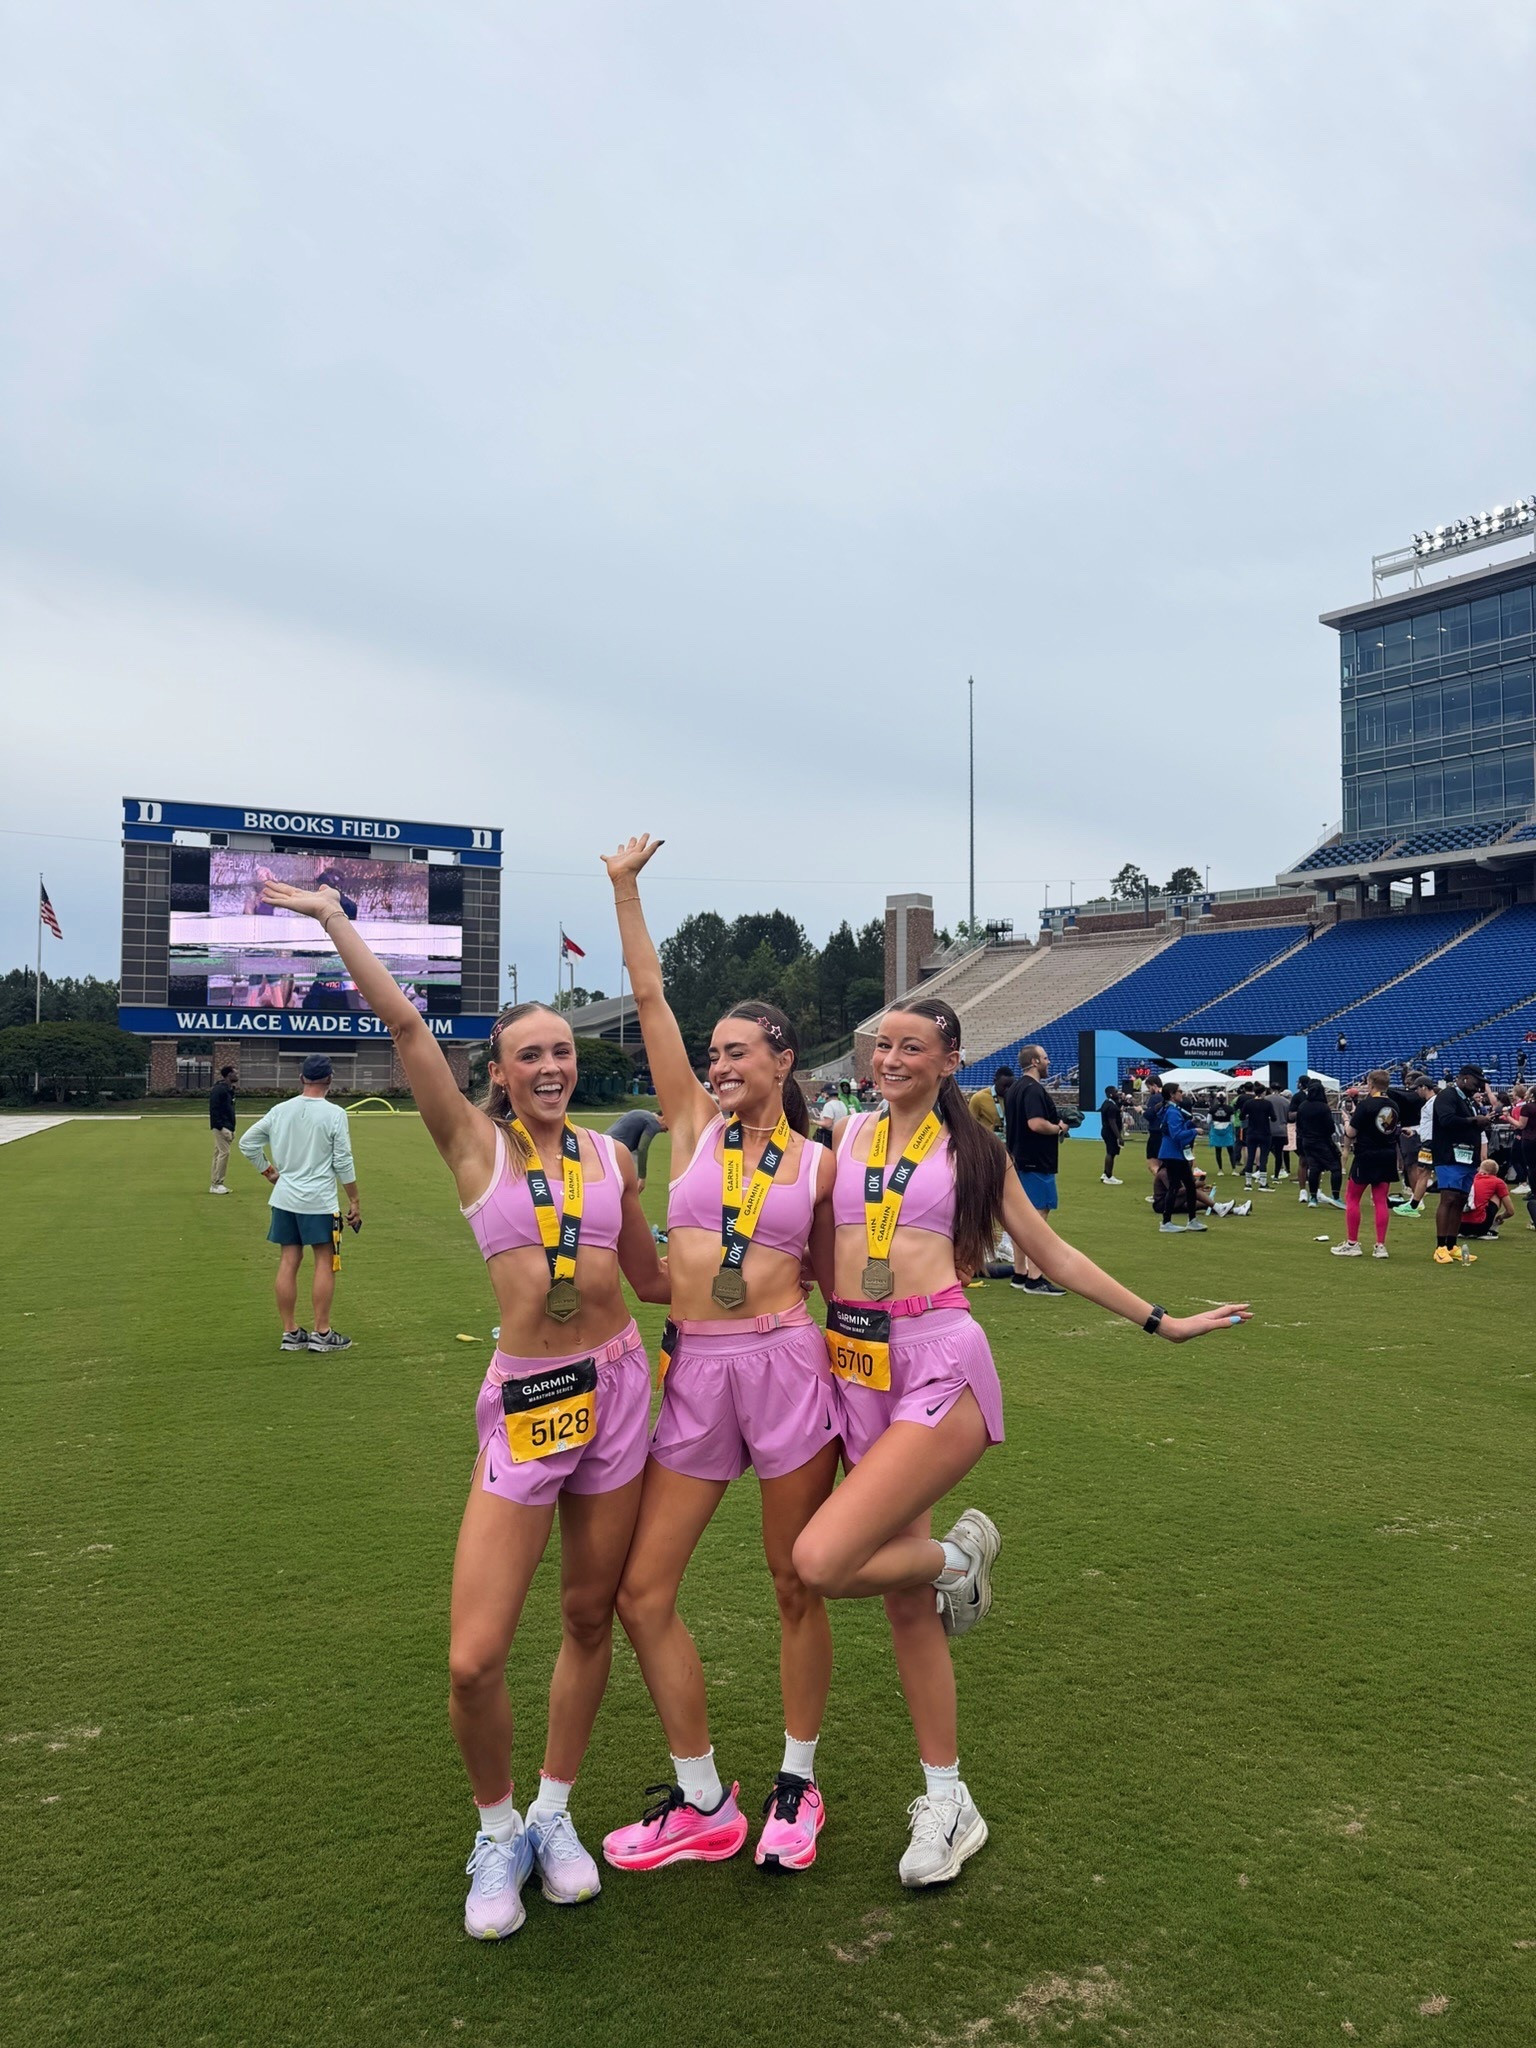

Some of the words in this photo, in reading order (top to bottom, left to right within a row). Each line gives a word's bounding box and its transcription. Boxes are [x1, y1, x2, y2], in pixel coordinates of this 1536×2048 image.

[243, 812, 334, 834] BROOKS
[341, 820, 400, 840] FIELD
[176, 1012, 282, 1031] WALLACE
[288, 1015, 352, 1032] WADE
[566, 1134, 577, 1153] 10K
[728, 1129, 739, 1142] 10K
[912, 1124, 931, 1150] GARMIN
[764, 1150, 778, 1168] 10K
[868, 1175, 880, 1192] 10K
[894, 1165, 910, 1184] 10K
[531, 1179, 548, 1197] 10K
[744, 1183, 760, 1216] GARMIN
[877, 1206, 891, 1242] GARMIN
[563, 1225, 577, 1247] 10K
[728, 1242, 744, 1264] 10K
[837, 1346, 873, 1377] 5710
[531, 1408, 589, 1447] 5128
